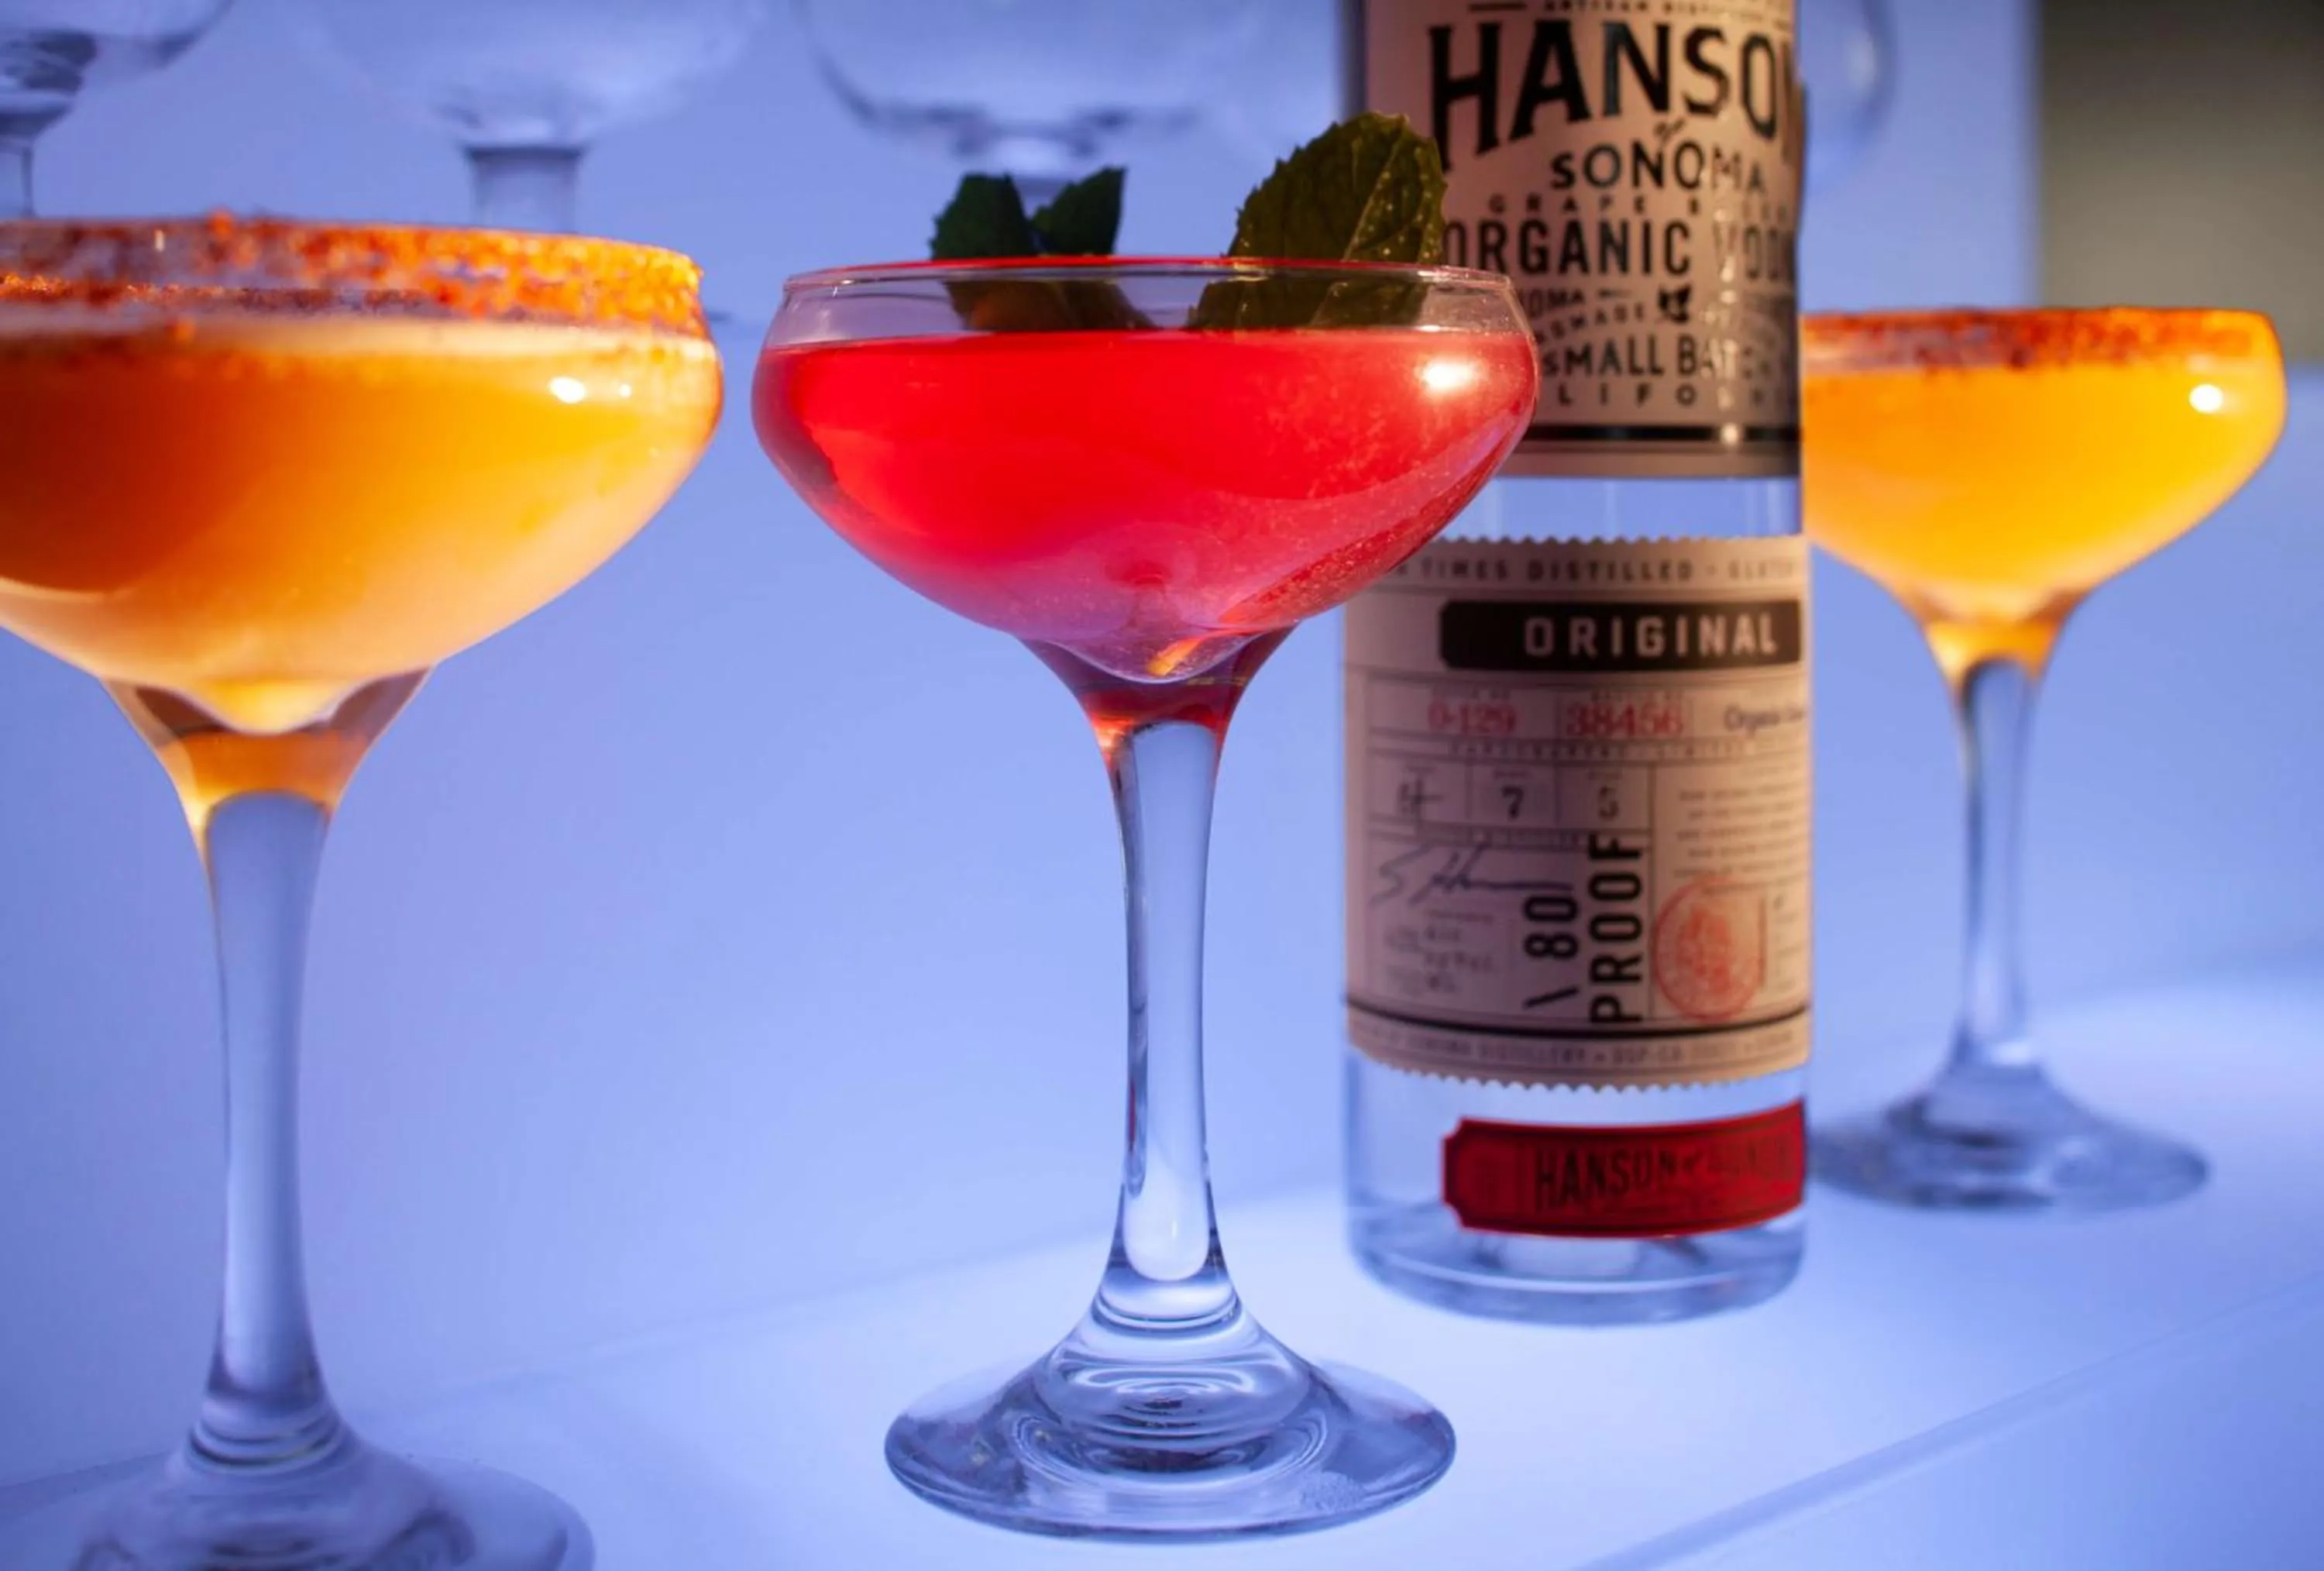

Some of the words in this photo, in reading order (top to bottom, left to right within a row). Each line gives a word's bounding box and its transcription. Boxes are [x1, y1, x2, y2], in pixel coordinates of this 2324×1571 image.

[1552, 140, 1767, 192] SONOMA
[1442, 219, 1690, 276] ORGANIC
[1541, 335, 1665, 377] SMALL
[1525, 615, 1778, 658] ORIGINAL
[1501, 785, 1526, 822] 7
[1522, 894, 1580, 960] 80
[1588, 830, 1644, 1025] PROOF
